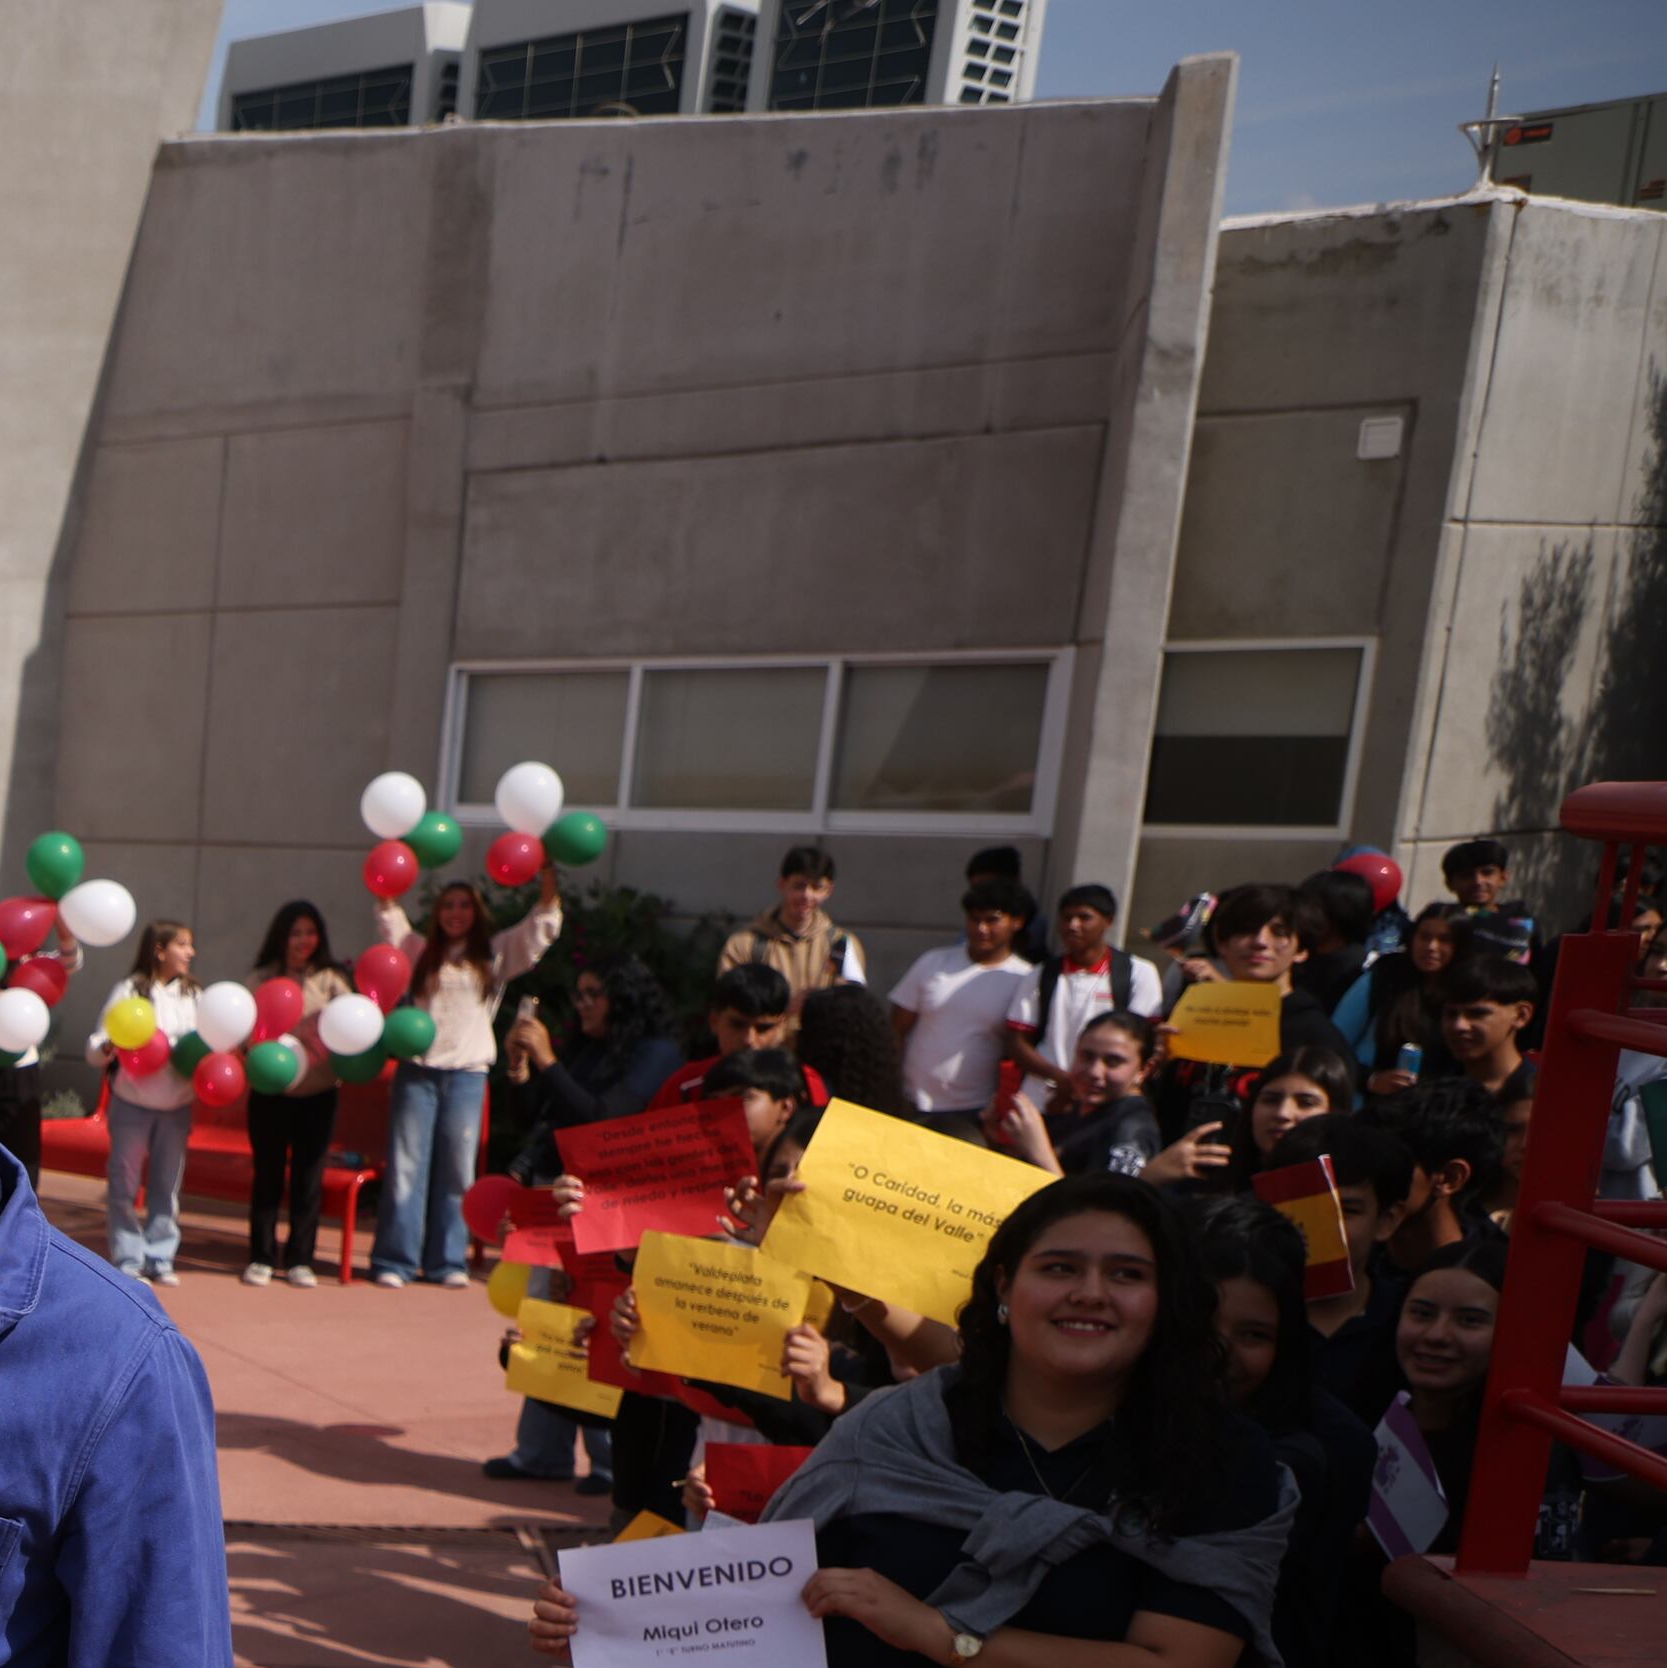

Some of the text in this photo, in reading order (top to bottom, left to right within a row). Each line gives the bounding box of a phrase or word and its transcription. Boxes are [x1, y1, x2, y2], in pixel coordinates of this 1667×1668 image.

[842, 1187, 898, 1216] guapa
[901, 1207, 931, 1228] del
[945, 1197, 964, 1215] la
[675, 1297, 760, 1325] la verbena de
[715, 1286, 769, 1308] después
[771, 1297, 790, 1312] de
[610, 1556, 793, 1600] BIENVENIDO
[643, 1615, 764, 1641] Miqui Otero
